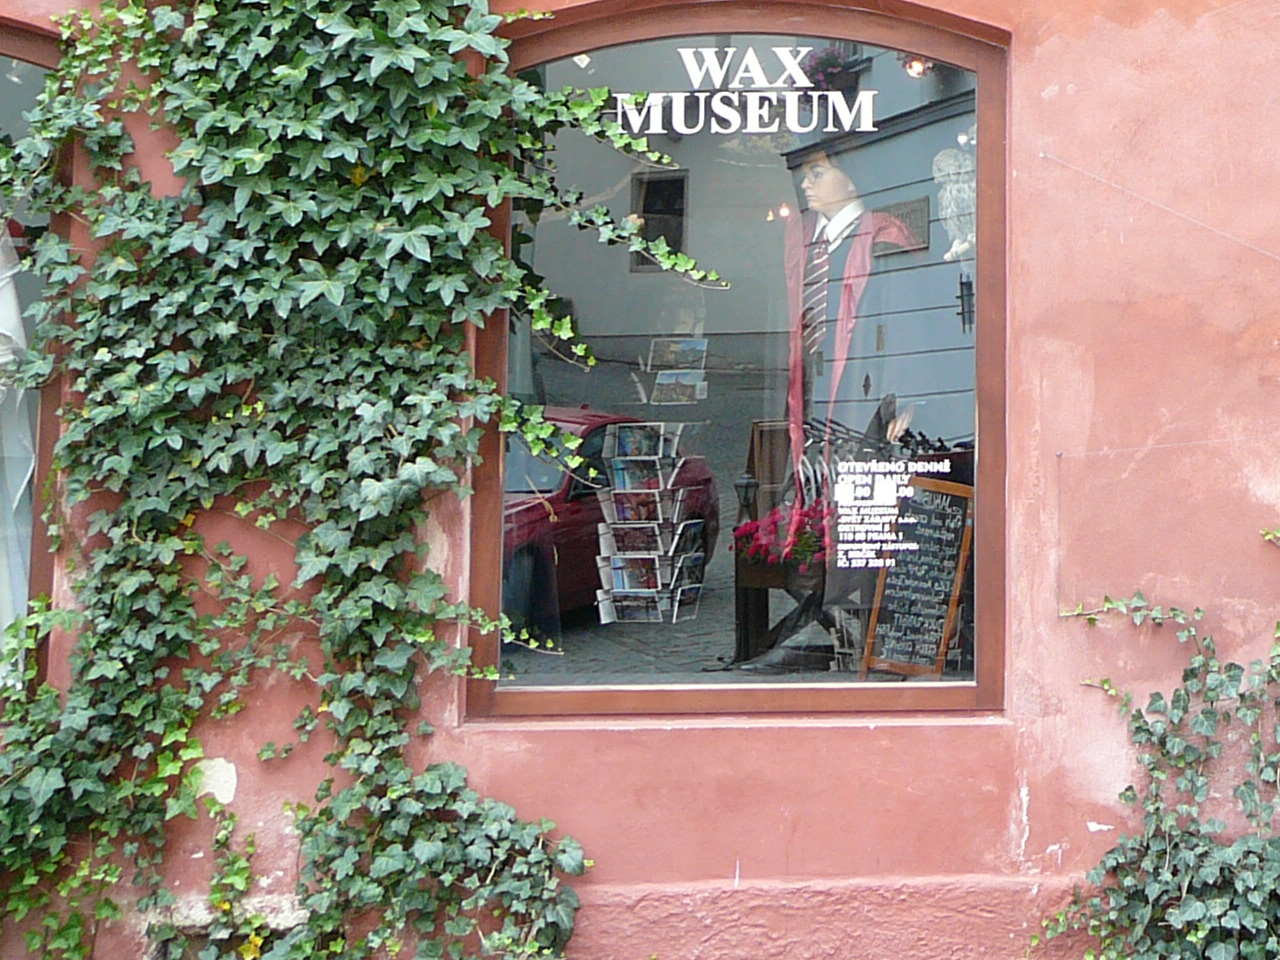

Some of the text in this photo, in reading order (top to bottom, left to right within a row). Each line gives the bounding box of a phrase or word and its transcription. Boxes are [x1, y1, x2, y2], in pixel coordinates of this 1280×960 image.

[677, 46, 815, 89] WAX
[614, 90, 879, 135] MUSEUM
[838, 474, 872, 484] OPEN
